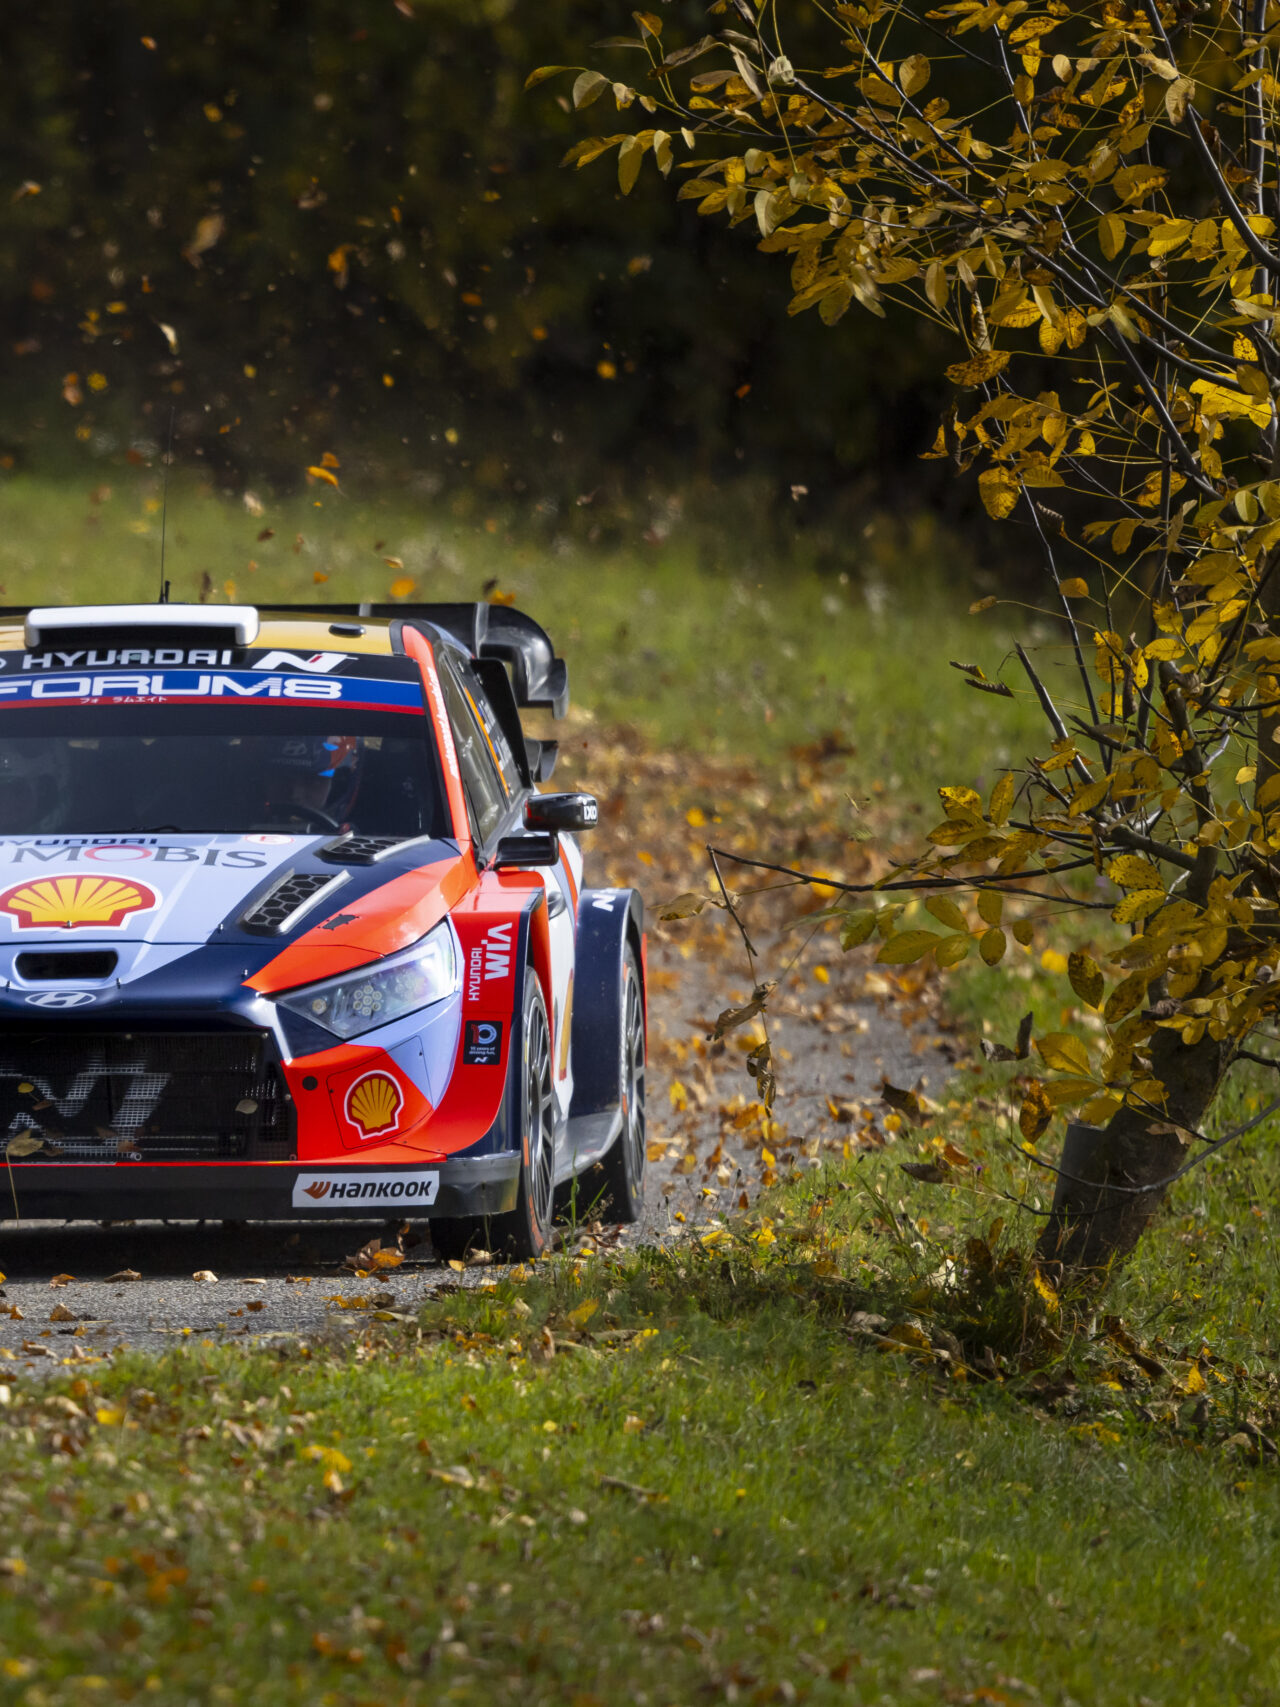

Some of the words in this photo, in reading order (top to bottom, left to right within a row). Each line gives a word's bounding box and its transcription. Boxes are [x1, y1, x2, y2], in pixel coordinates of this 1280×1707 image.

[22, 648, 232, 669] HYUNDAI
[80, 696, 167, 704] フォラムエイト
[11, 844, 268, 868] MOBIS
[468, 947, 483, 1001] HYUNDAI
